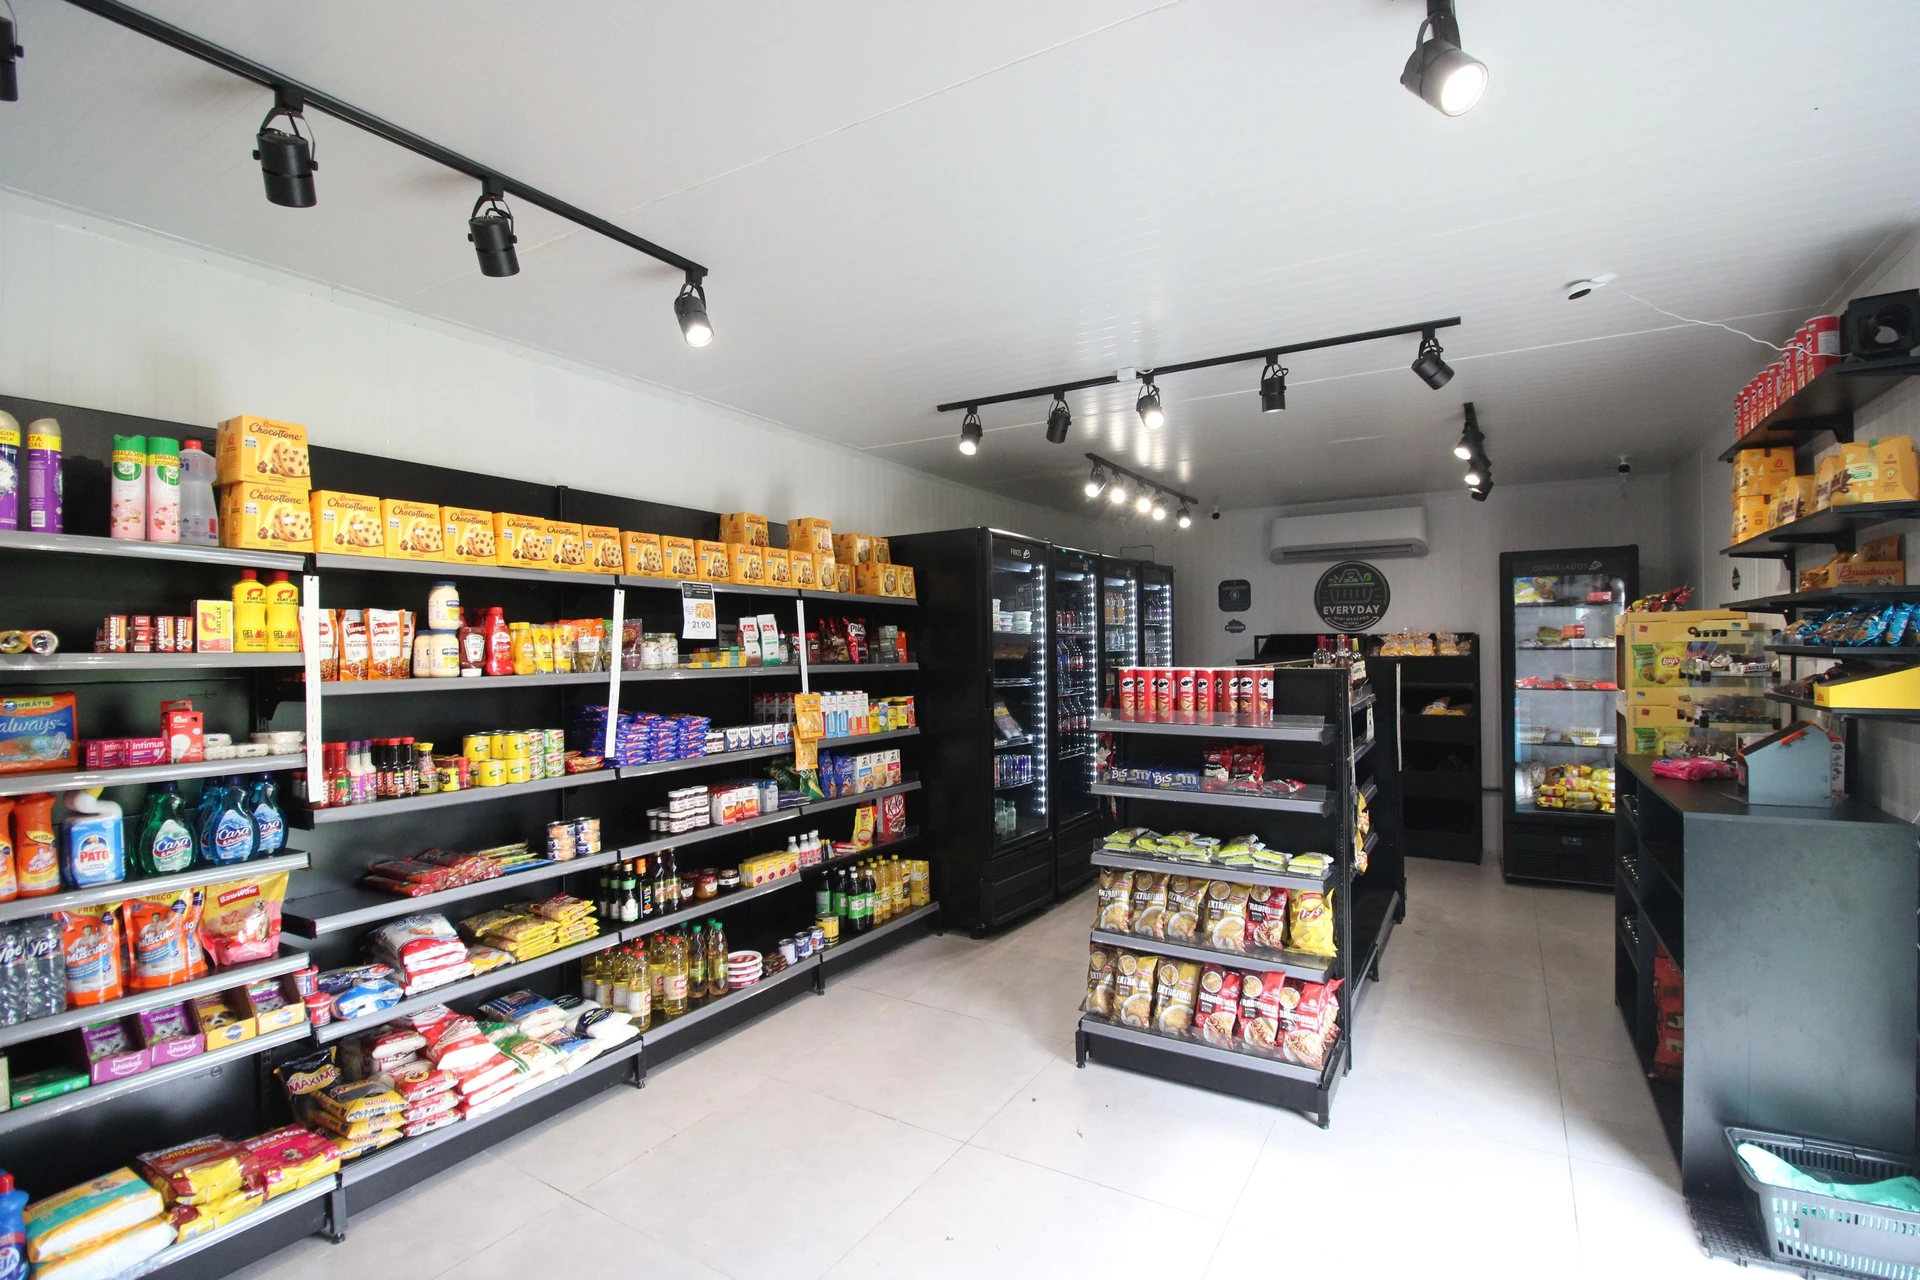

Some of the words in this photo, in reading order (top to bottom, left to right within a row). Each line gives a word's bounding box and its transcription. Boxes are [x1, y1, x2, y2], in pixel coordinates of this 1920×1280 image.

[249, 422, 301, 440] Chocottone
[250, 488, 302, 505] Chocottone
[328, 496, 374, 512] Chocottone
[392, 505, 435, 519] Chocottone
[450, 512, 488, 526] Chocottone
[507, 518, 541, 531] Chocottone
[547, 524, 579, 537] Chocottone
[587, 529, 617, 540] Chocottone
[1532, 563, 1588, 572] CONGELADOS
[1838, 564, 1898, 579] Bauducco
[1323, 605, 1380, 615] EVERYDAY
[0, 718, 56, 735] always
[259, 820, 279, 831] asa
[219, 827, 249, 839] Casa
[156, 837, 188, 851] Casa
[79, 850, 109, 863] PATO
[146, 893, 172, 902] PREÇO
[1134, 891, 1165, 900] EXTRAFINA
[1157, 984, 1192, 1000] EXTRAFINA
[150, 1011, 180, 1023] whiskas
[90, 1028, 120, 1040] whiskas
[167, 1043, 196, 1055] whiskas
[110, 1060, 142, 1072] whiskas
[288, 1068, 336, 1095] MÁXIMO
[161, 1151, 185, 1161] GATO
